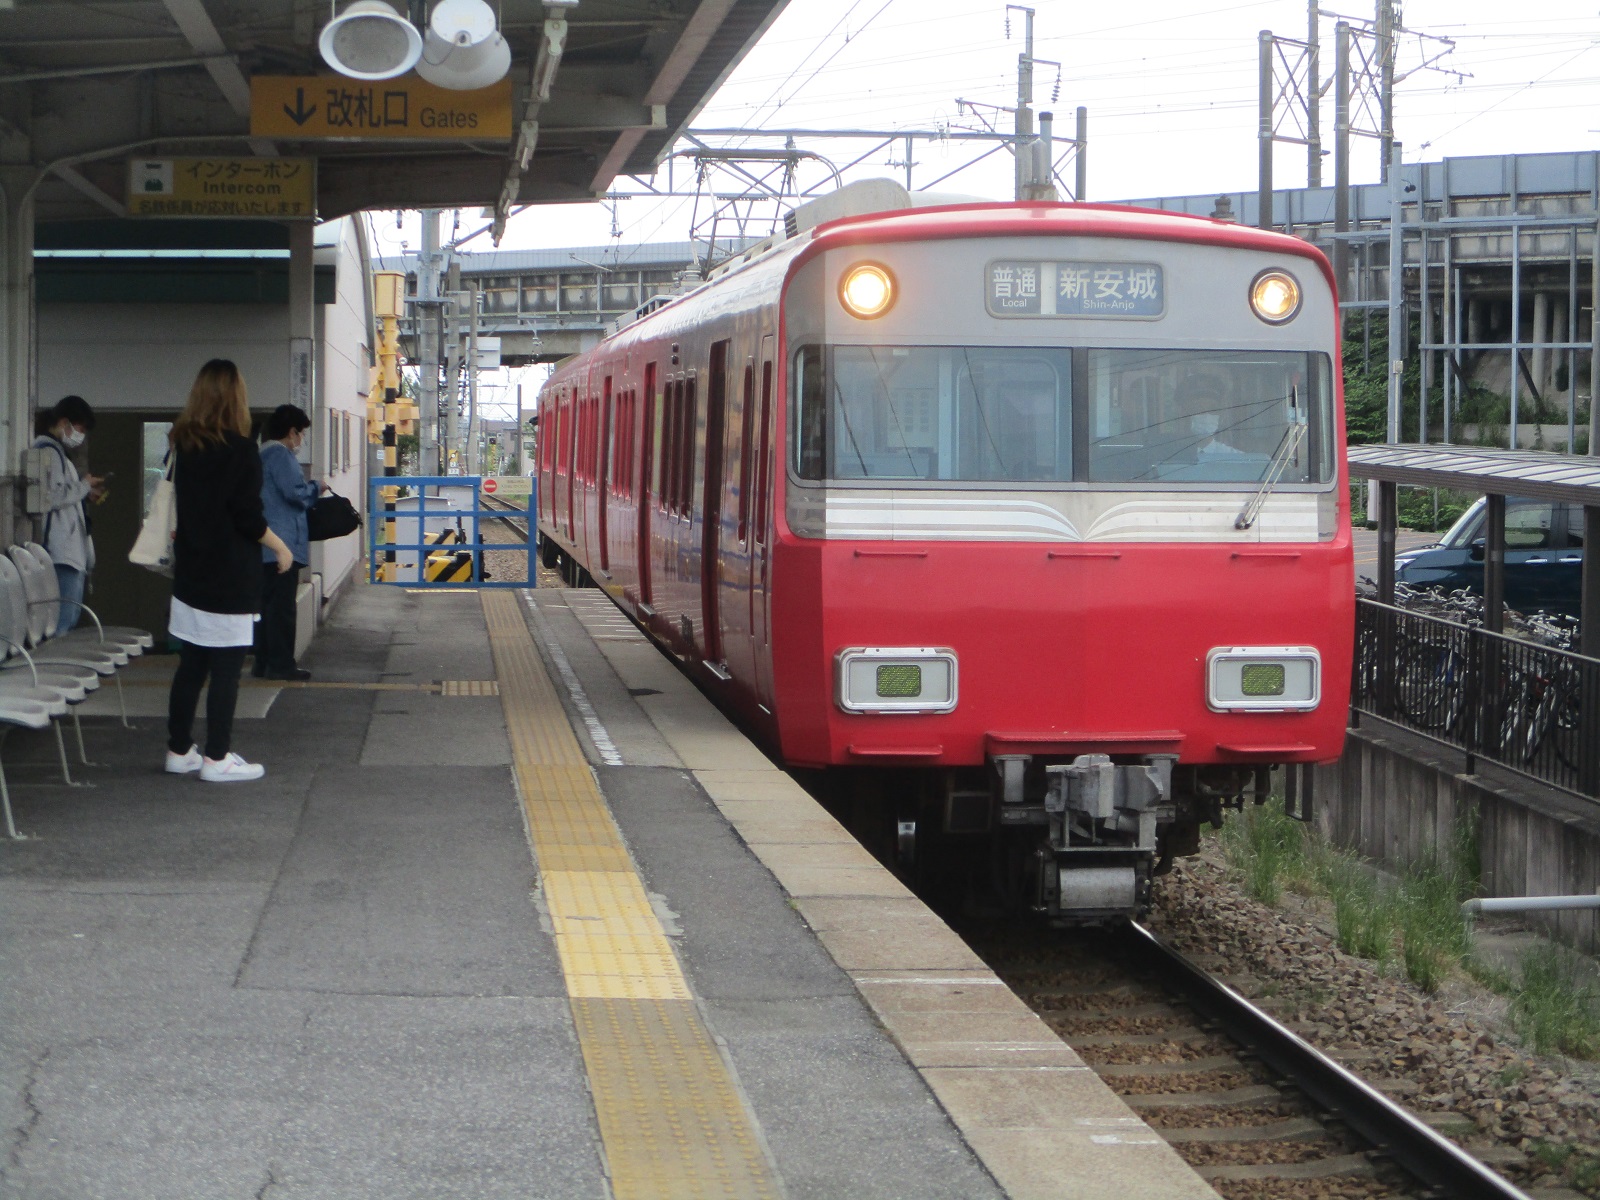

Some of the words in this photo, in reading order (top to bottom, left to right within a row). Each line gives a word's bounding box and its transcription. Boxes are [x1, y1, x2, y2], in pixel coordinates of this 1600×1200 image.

[326, 88, 408, 128] 改札口
[420, 107, 479, 129] Gates
[185, 160, 301, 179] インターホン
[203, 181, 281, 195] Intercom
[993, 266, 1037, 298] 普通
[1060, 268, 1157, 299] 新安城
[1002, 298, 1027, 307] Local
[1084, 300, 1135, 311] Shin-Anjo
